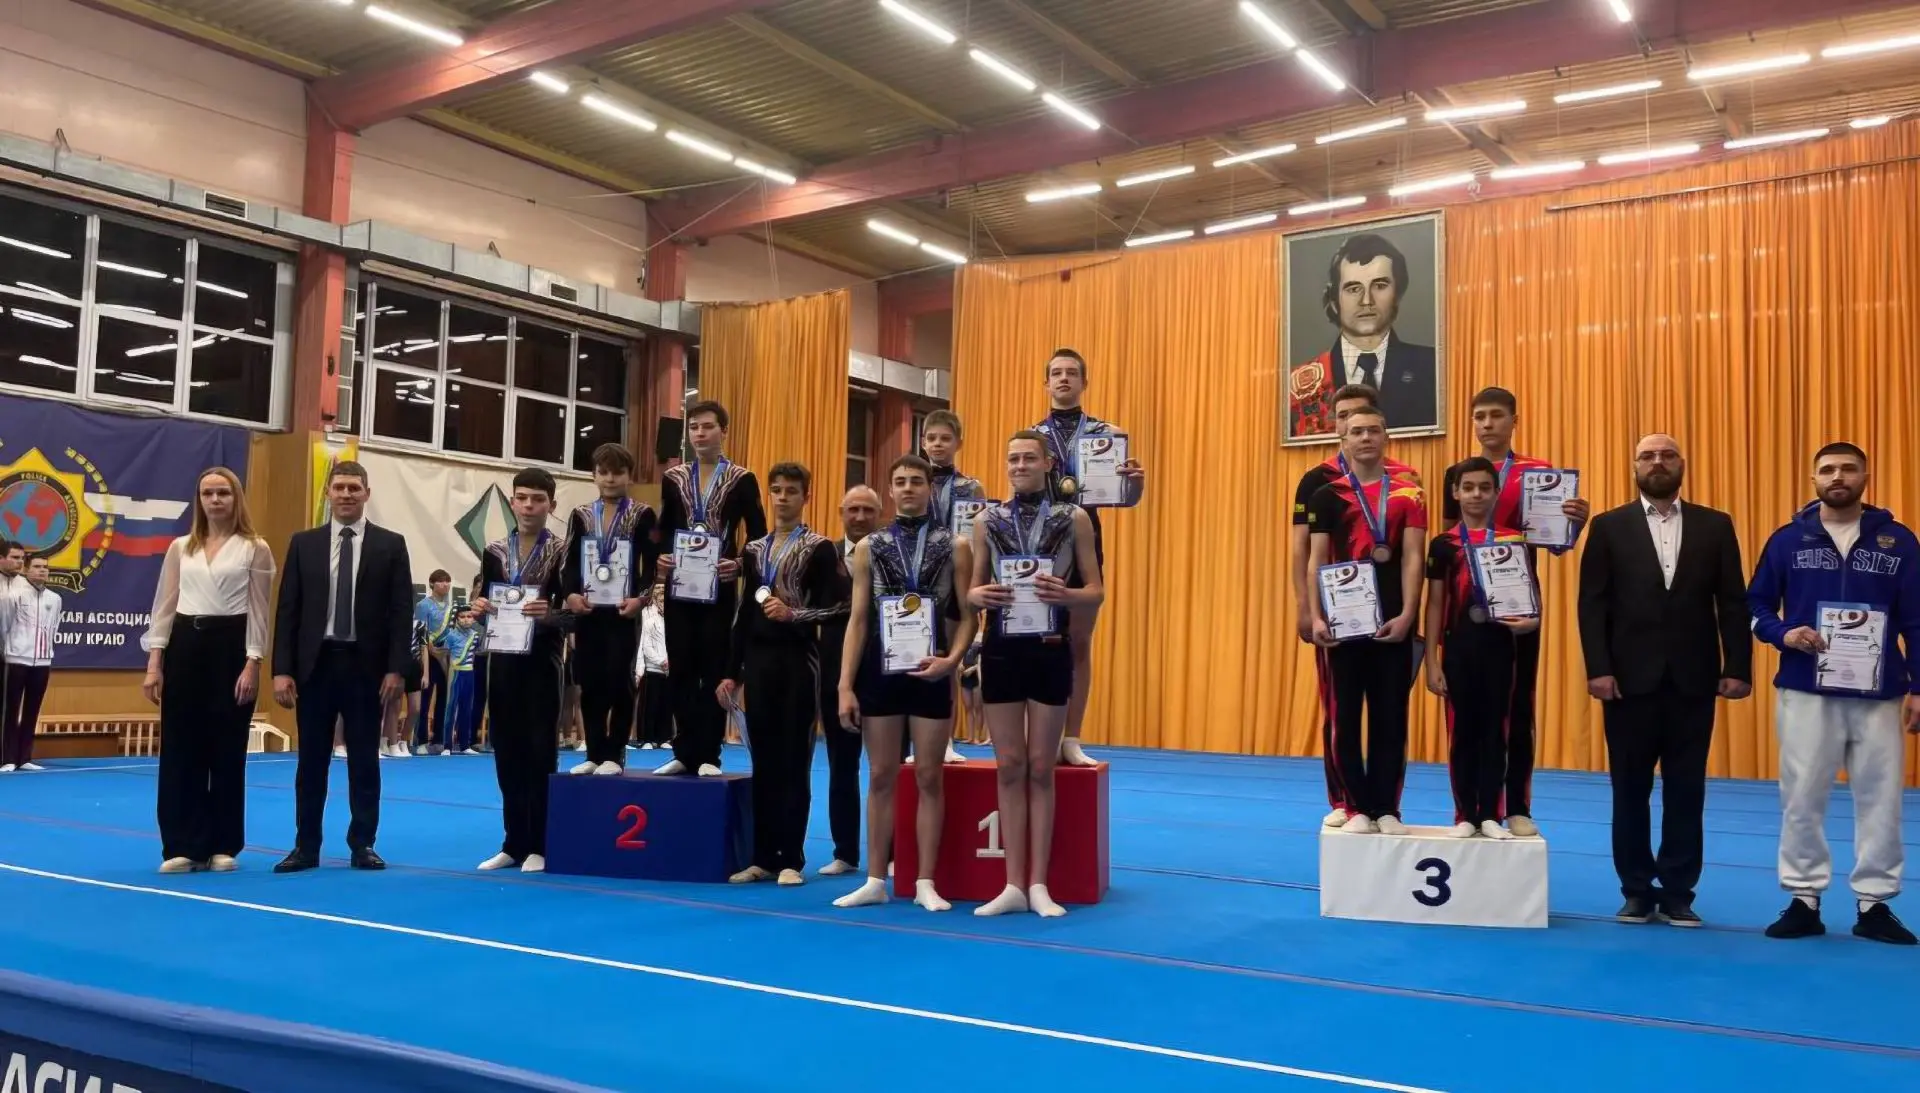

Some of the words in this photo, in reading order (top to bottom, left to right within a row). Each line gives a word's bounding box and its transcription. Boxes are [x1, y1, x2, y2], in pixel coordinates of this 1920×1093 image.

[86, 633, 125, 646] КРАЮ
[87, 612, 151, 627] АССОЦИА
[615, 804, 648, 849] 2
[976, 810, 1005, 858] 1
[1412, 857, 1452, 907] 3
